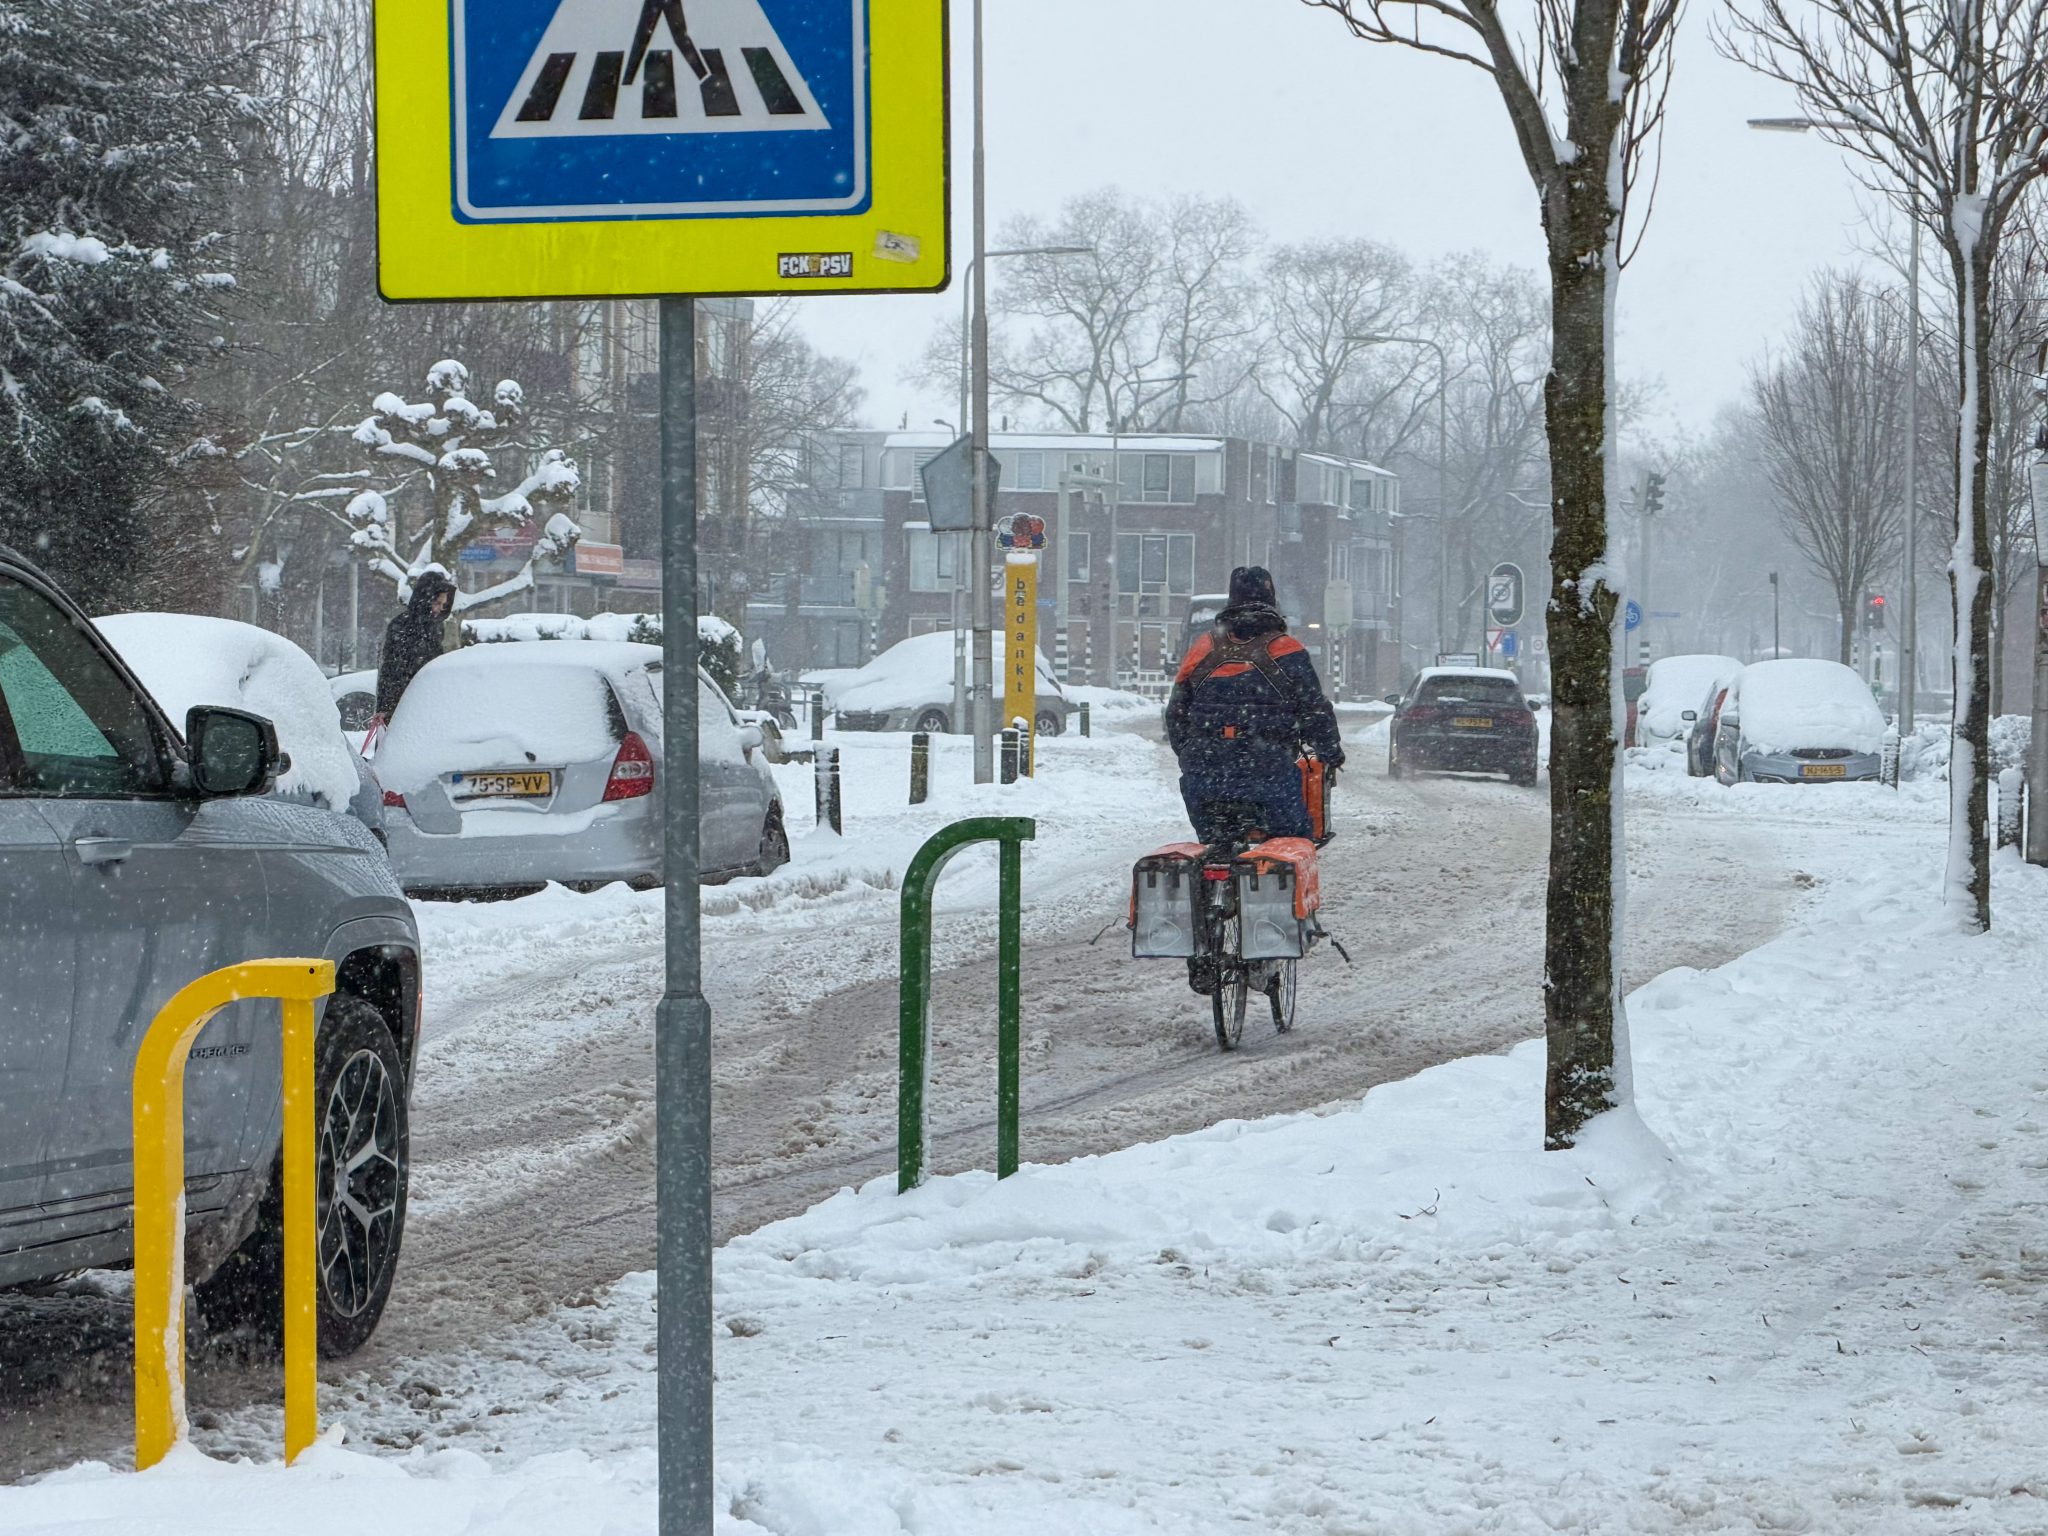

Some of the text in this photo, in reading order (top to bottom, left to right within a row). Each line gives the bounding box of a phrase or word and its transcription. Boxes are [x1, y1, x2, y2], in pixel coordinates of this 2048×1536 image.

[780, 254, 851, 276] FCK PSV
[1016, 577, 1026, 693] bedankt
